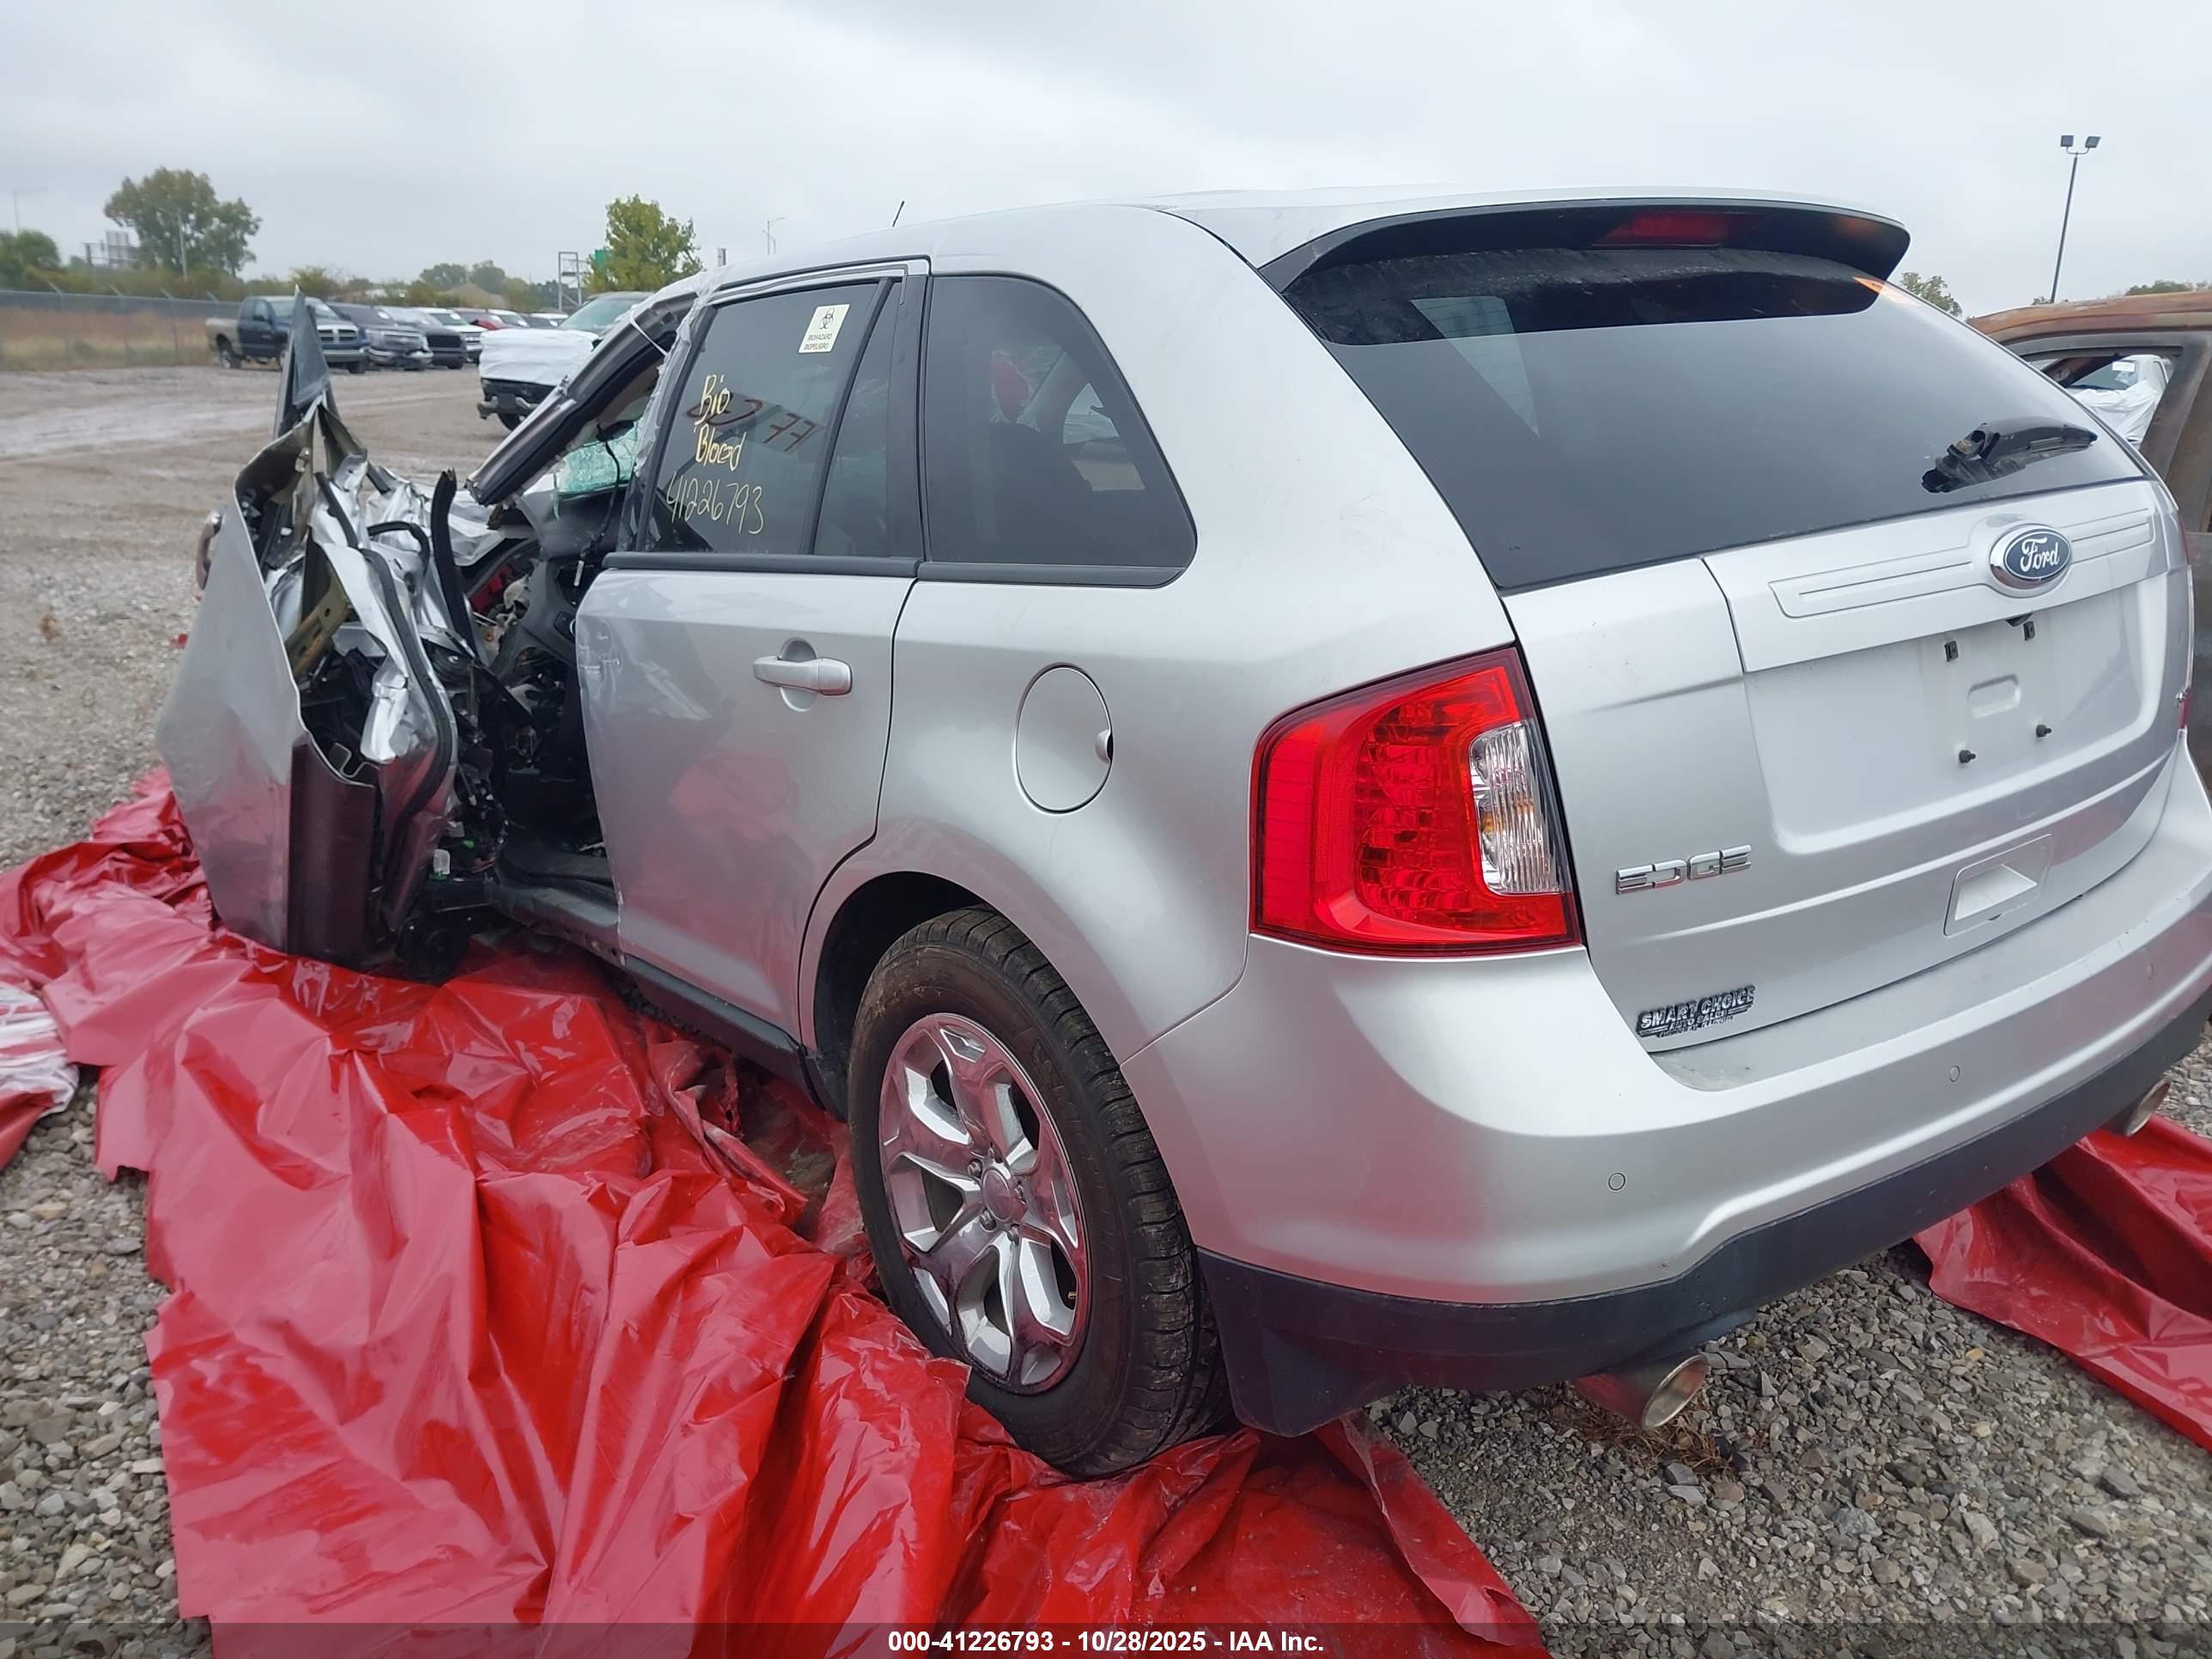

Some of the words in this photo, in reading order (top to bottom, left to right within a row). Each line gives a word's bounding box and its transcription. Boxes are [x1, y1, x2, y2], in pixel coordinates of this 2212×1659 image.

[695, 374, 732, 426] Bio
[666, 471, 764, 535] 41226793
[2020, 537, 2060, 572] Ford
[1616, 844, 1753, 895] EDGE
[1638, 1001, 1698, 1030] SMART
[1699, 986, 1756, 1015] CHOICE
[1668, 1018, 1695, 1030] AUTO
